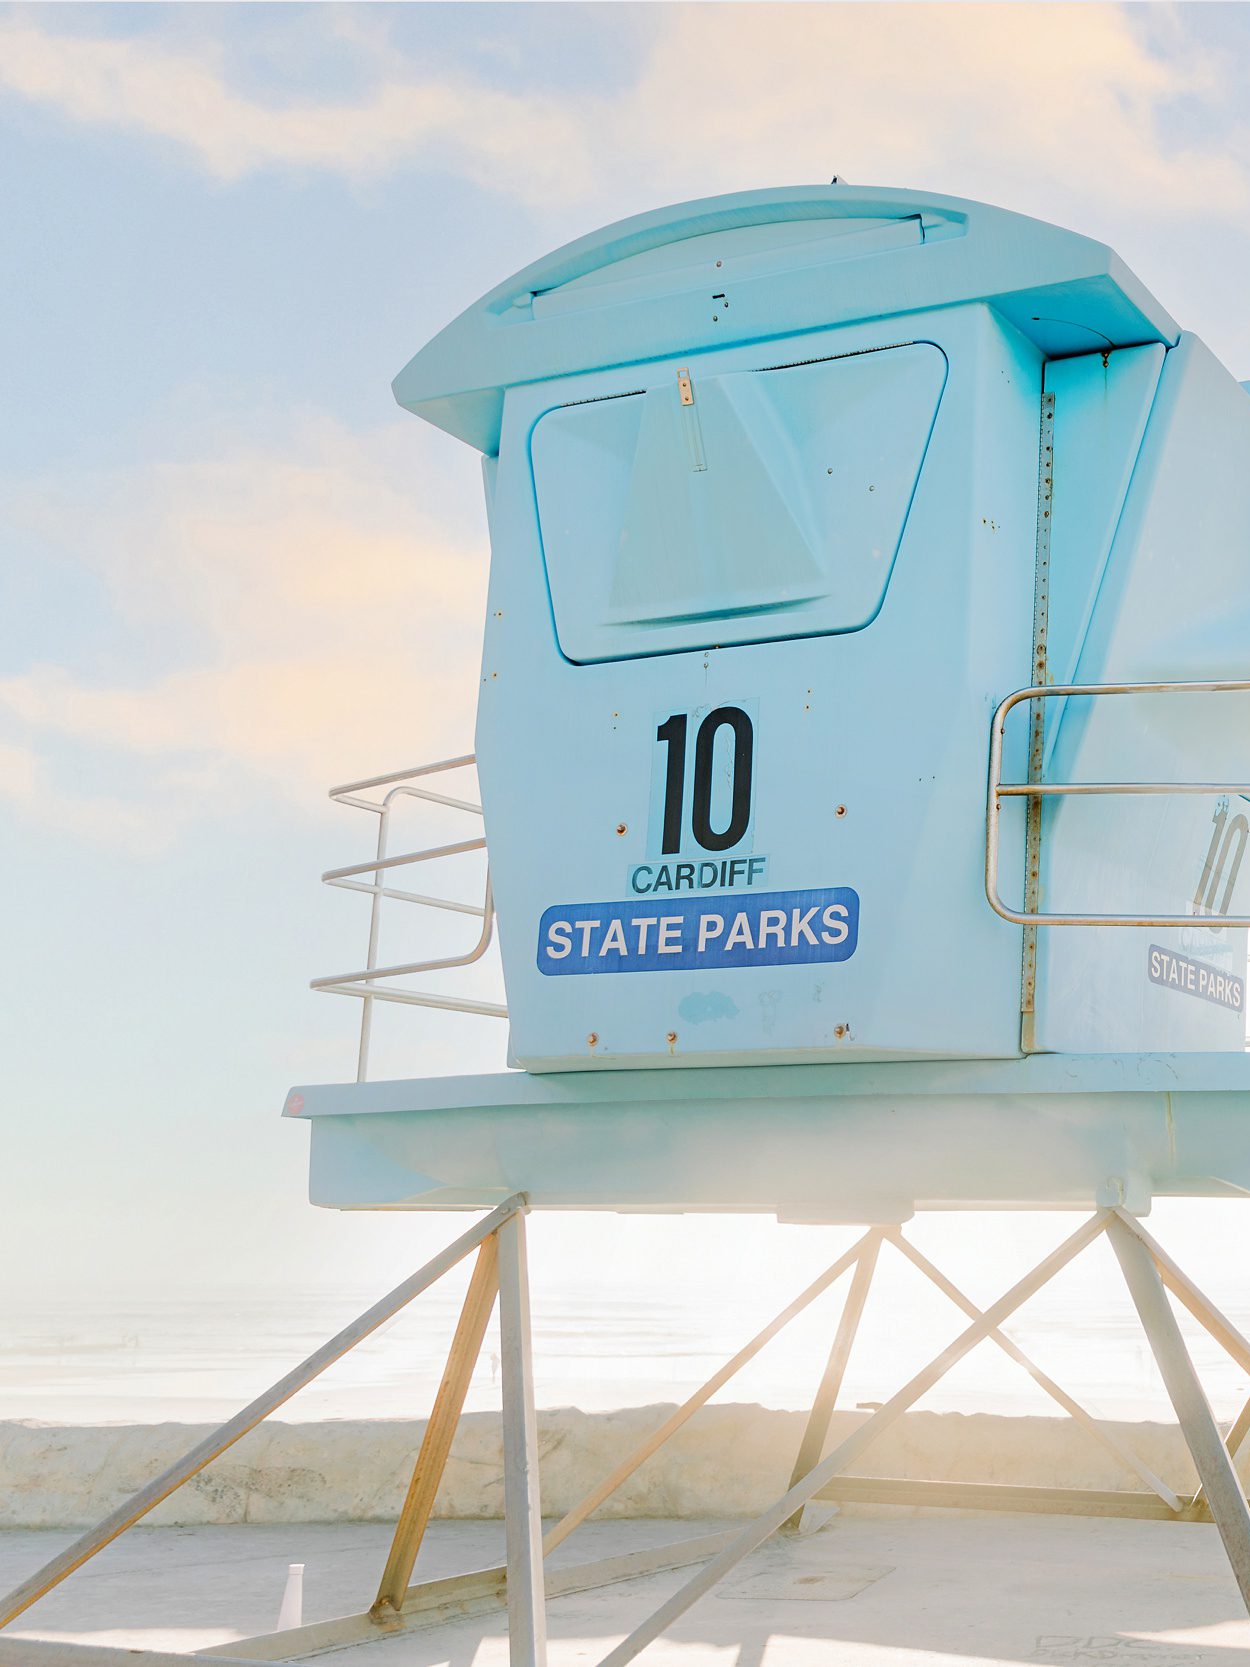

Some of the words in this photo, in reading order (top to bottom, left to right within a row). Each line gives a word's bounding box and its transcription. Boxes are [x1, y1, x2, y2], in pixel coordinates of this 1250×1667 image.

[656, 706, 754, 855] 10
[631, 857, 767, 894] CARDIFF
[1193, 810, 1249, 934] 10
[546, 916, 685, 959] STATE
[697, 904, 849, 953] PARKS
[1151, 951, 1196, 990] STATE
[1199, 968, 1242, 1007] PARKS
